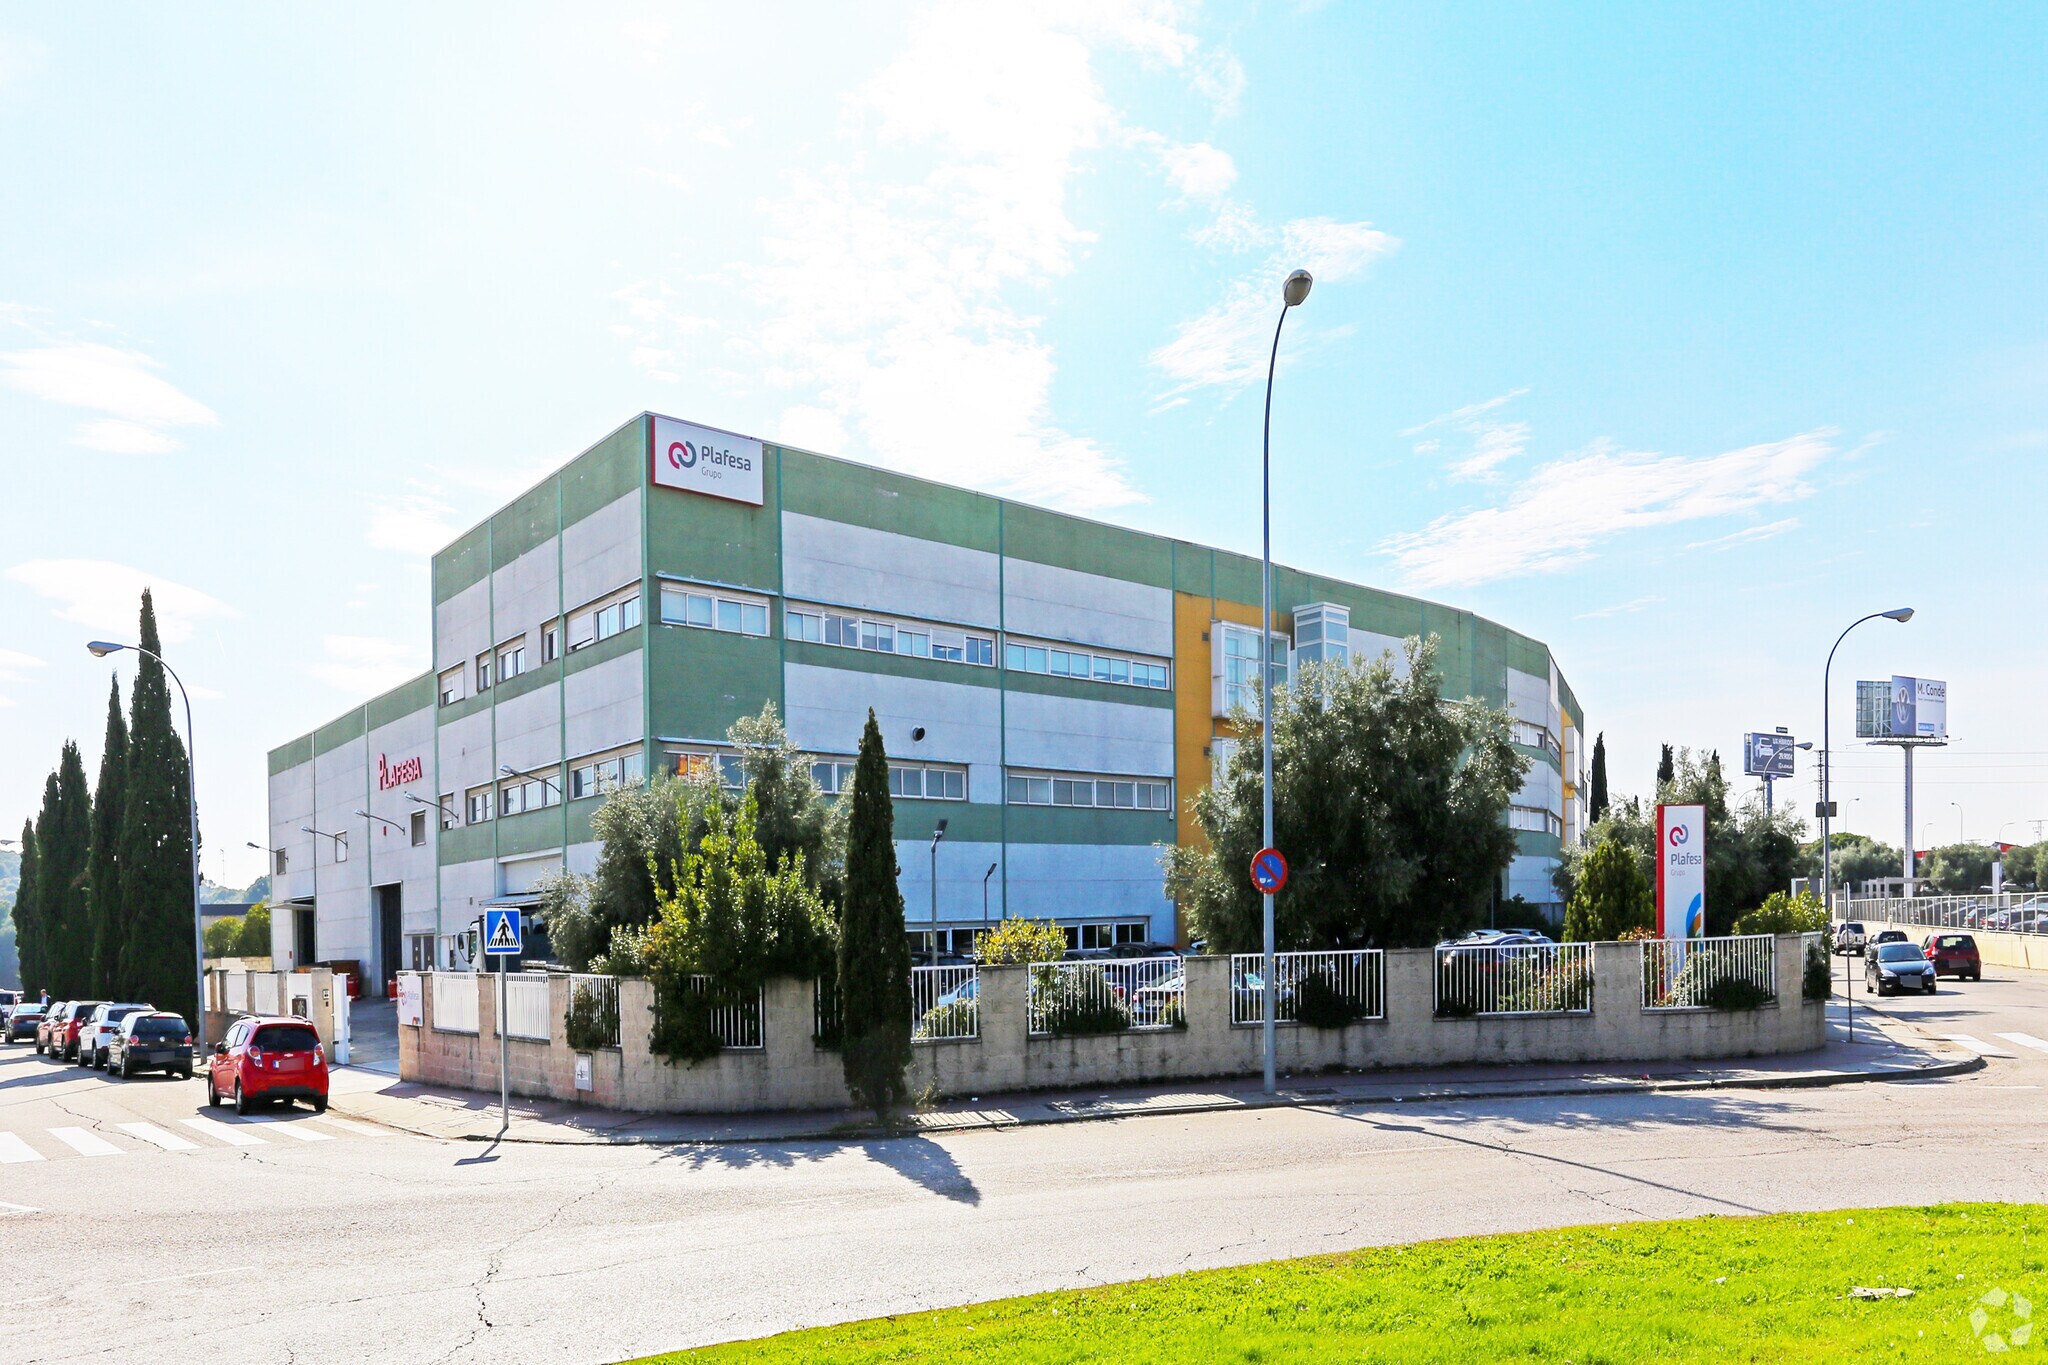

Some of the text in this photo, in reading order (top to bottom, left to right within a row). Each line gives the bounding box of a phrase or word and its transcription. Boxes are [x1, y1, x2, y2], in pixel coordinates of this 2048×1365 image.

[701, 446, 752, 471] Plafesa
[701, 466, 722, 479] Grupo
[1926, 684, 1945, 697] Conde
[379, 753, 422, 790] PLAFESA
[1670, 852, 1702, 865] Plafesa
